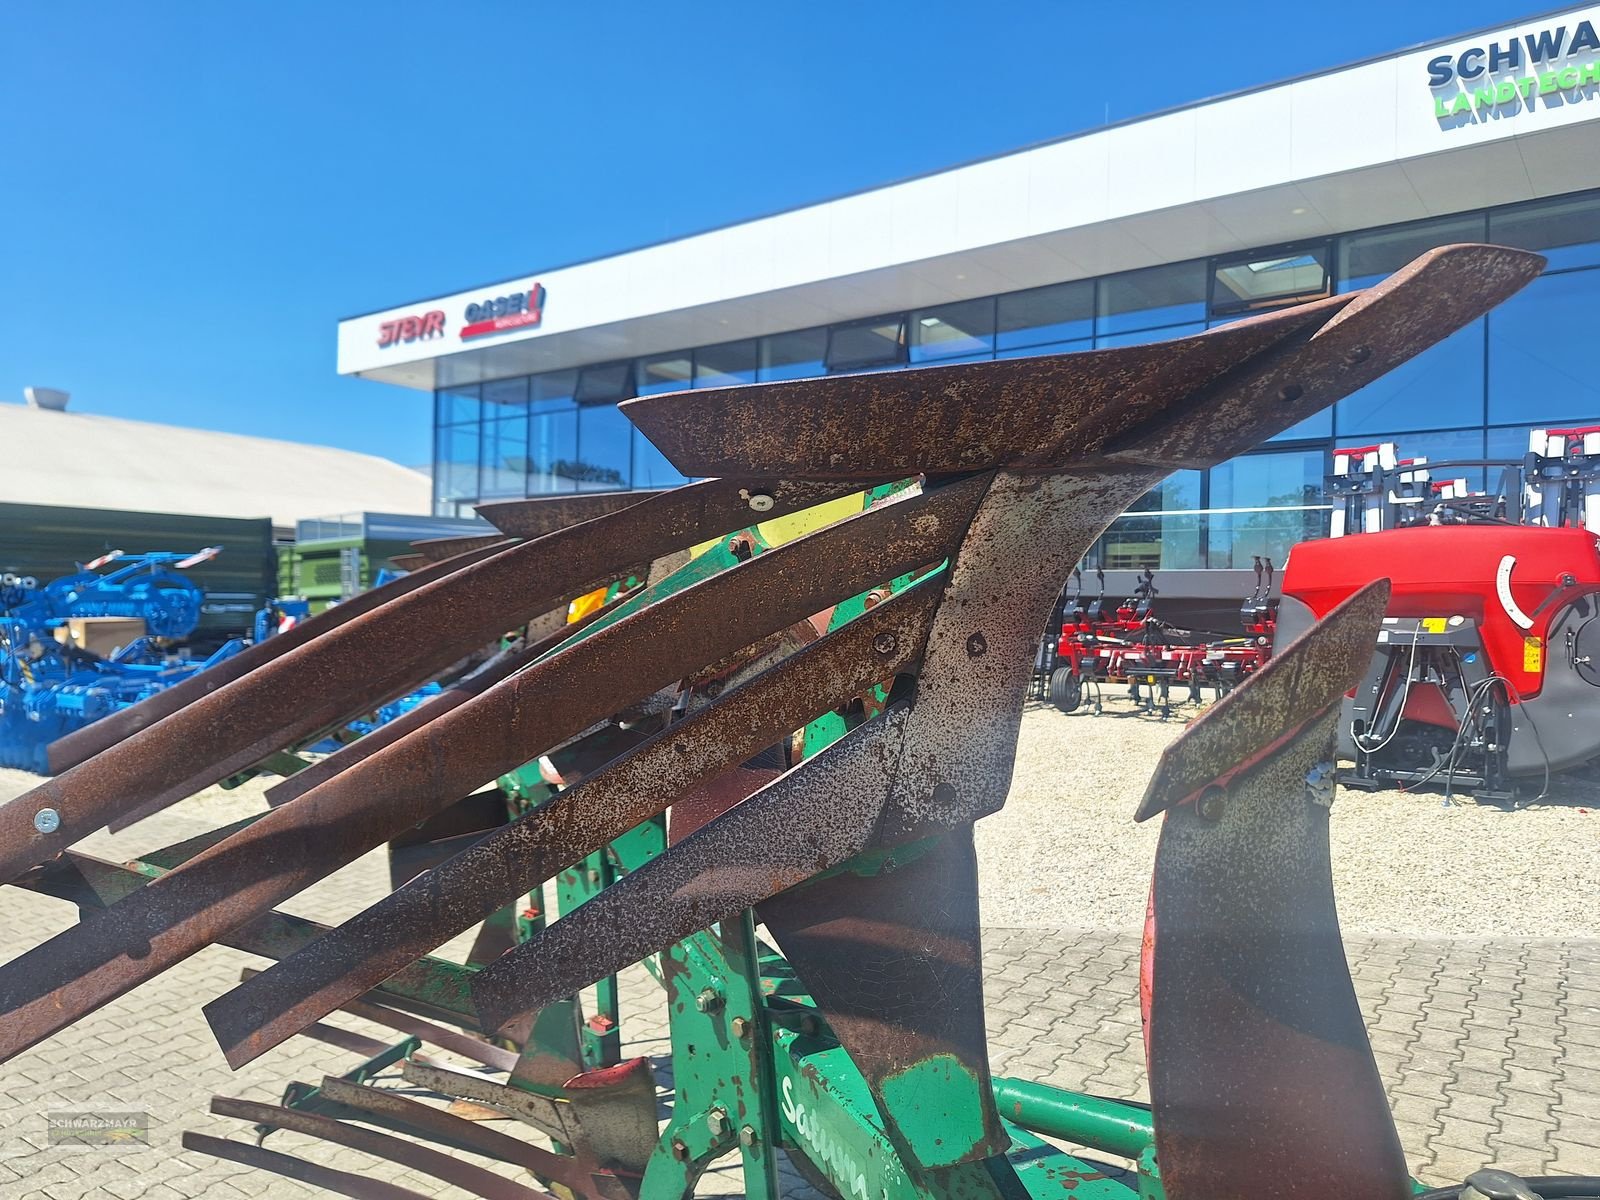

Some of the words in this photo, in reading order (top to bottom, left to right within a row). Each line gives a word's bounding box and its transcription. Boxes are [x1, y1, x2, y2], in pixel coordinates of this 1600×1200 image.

[1426, 20, 1600, 87] SCHWA
[1434, 60, 1600, 118] LANDTECH
[378, 310, 445, 346] STEYR
